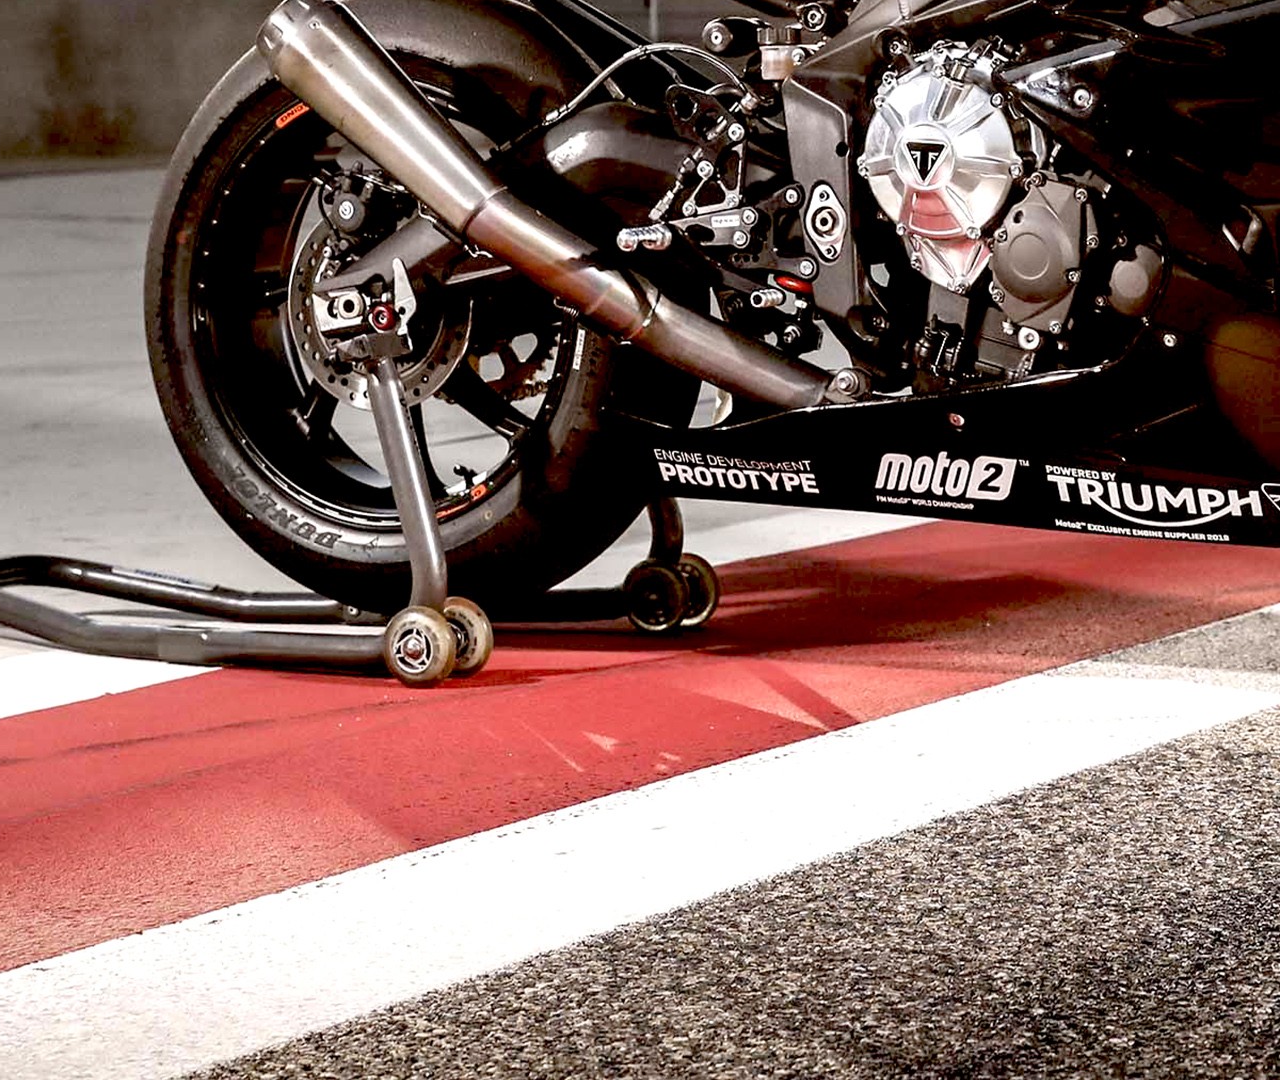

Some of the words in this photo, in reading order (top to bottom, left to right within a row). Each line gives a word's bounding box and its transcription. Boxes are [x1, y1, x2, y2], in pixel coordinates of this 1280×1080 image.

[653, 448, 703, 465] ENGINE
[706, 453, 811, 471] DEVELOPMENT
[658, 462, 820, 494] PROTOTYPE
[1045, 464, 1100, 480] POWERED
[1101, 471, 1116, 482] BY
[1046, 474, 1264, 527] TRIUMPH
[1087, 523, 1132, 536] EXCLUSIVE
[1132, 528, 1163, 538] ENGINE
[1164, 531, 1206, 541] SUPPLIER
